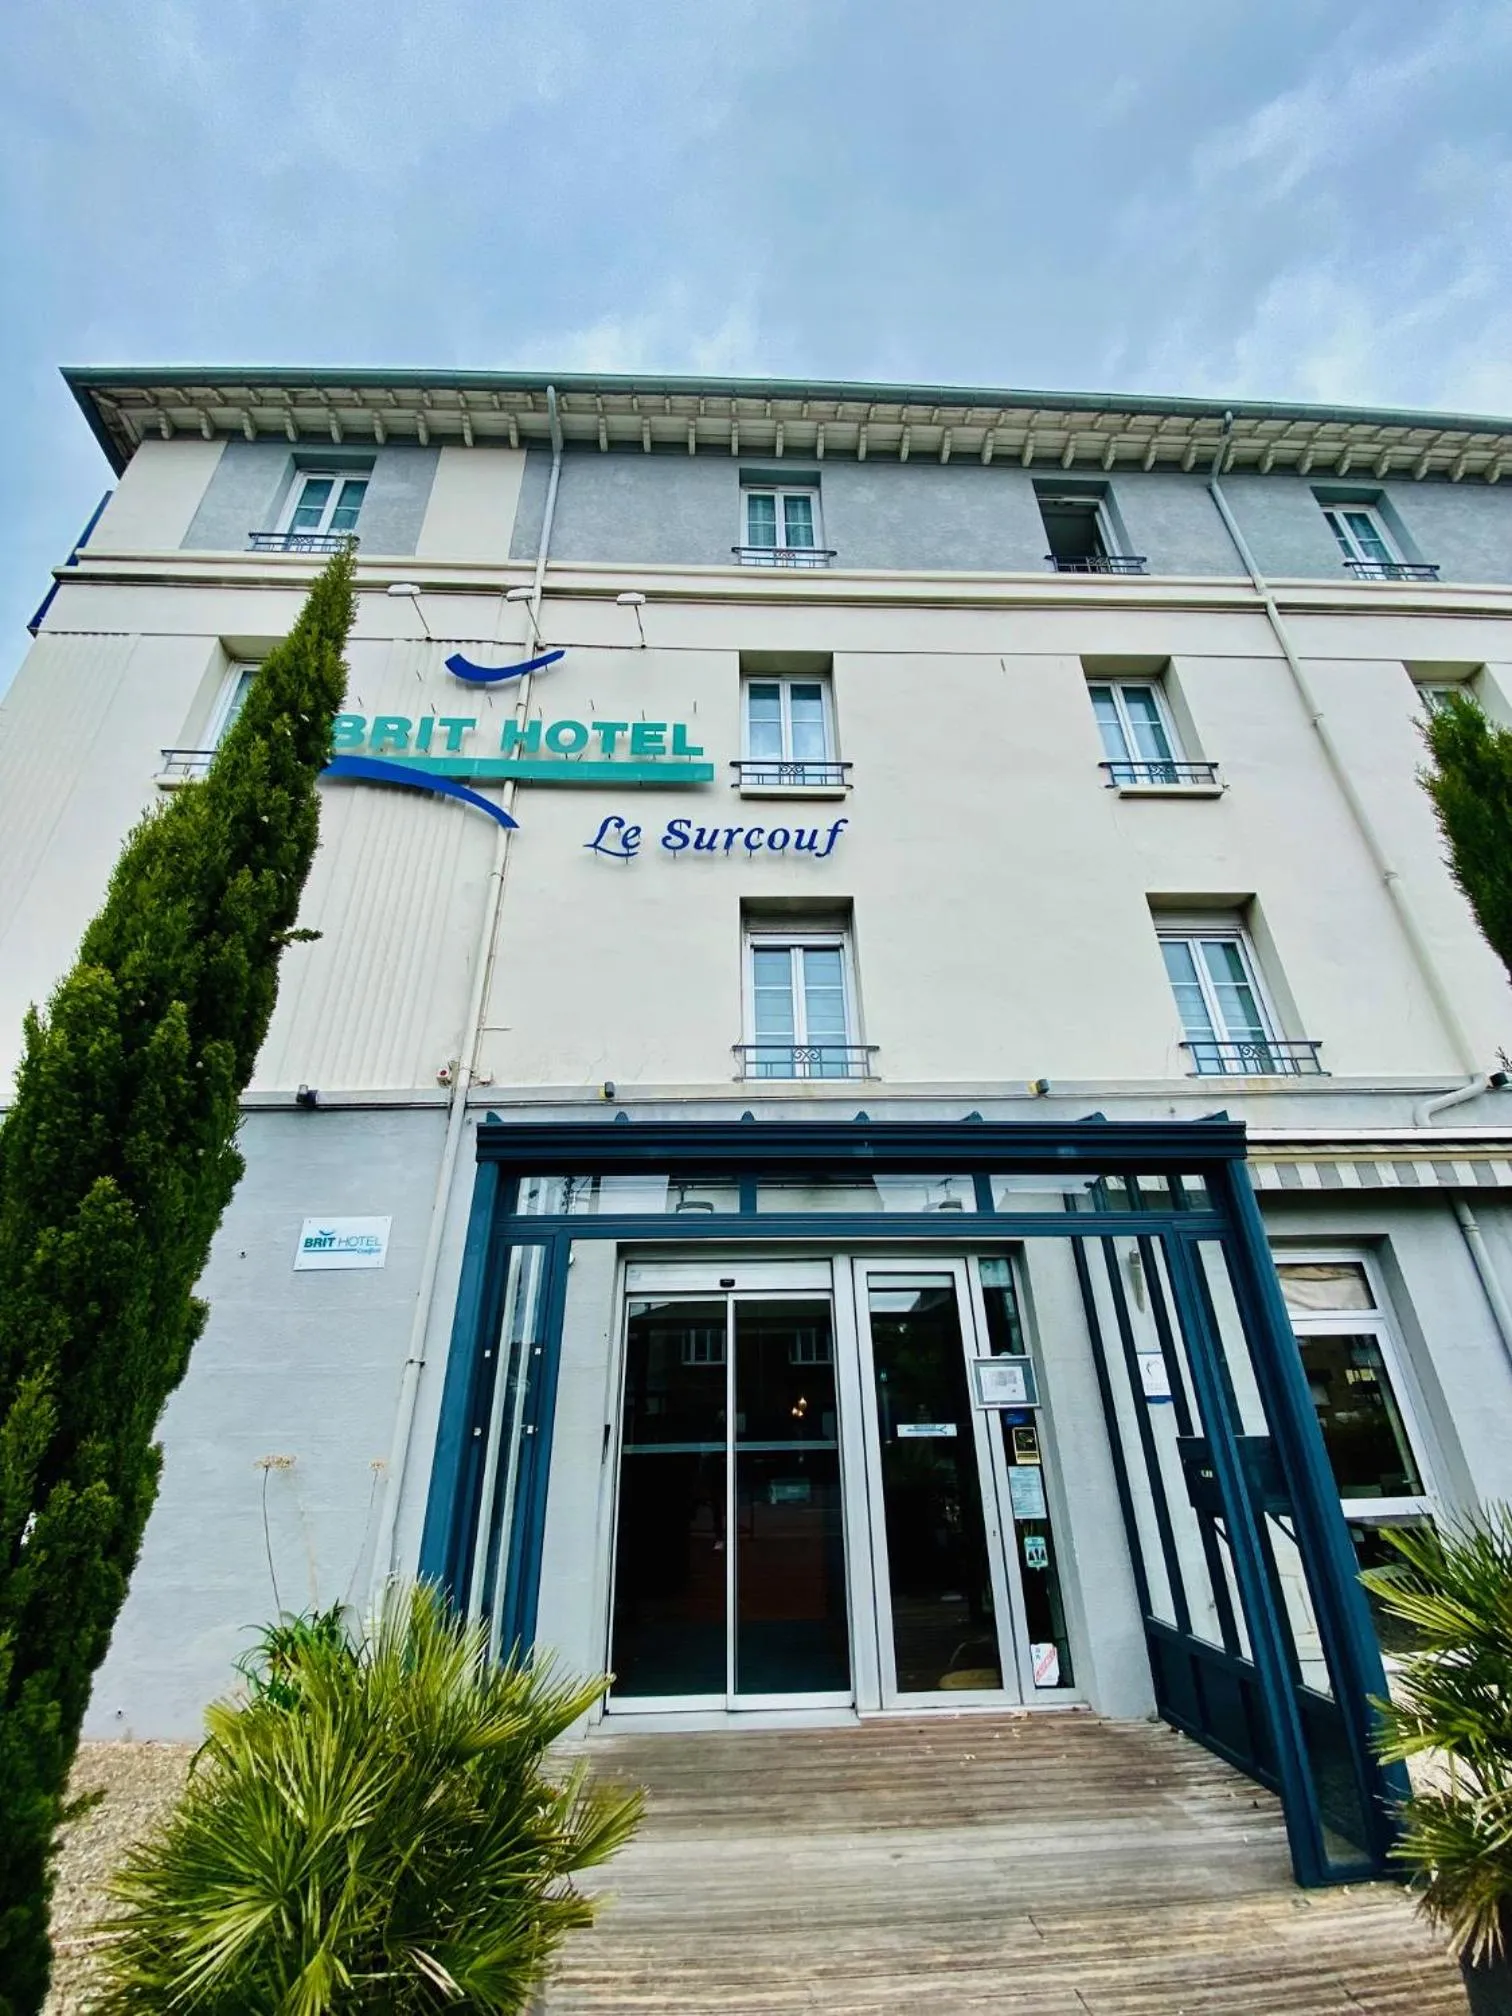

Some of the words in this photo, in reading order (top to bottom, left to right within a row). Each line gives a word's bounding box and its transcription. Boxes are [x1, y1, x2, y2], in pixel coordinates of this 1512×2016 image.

[333, 714, 477, 752] BRIT
[500, 717, 704, 757] HOTEL
[584, 815, 642, 858] Le
[660, 817, 849, 859] Surcouf
[304, 1238, 336, 1248] BRIT
[338, 1236, 382, 1247] HOTEL
